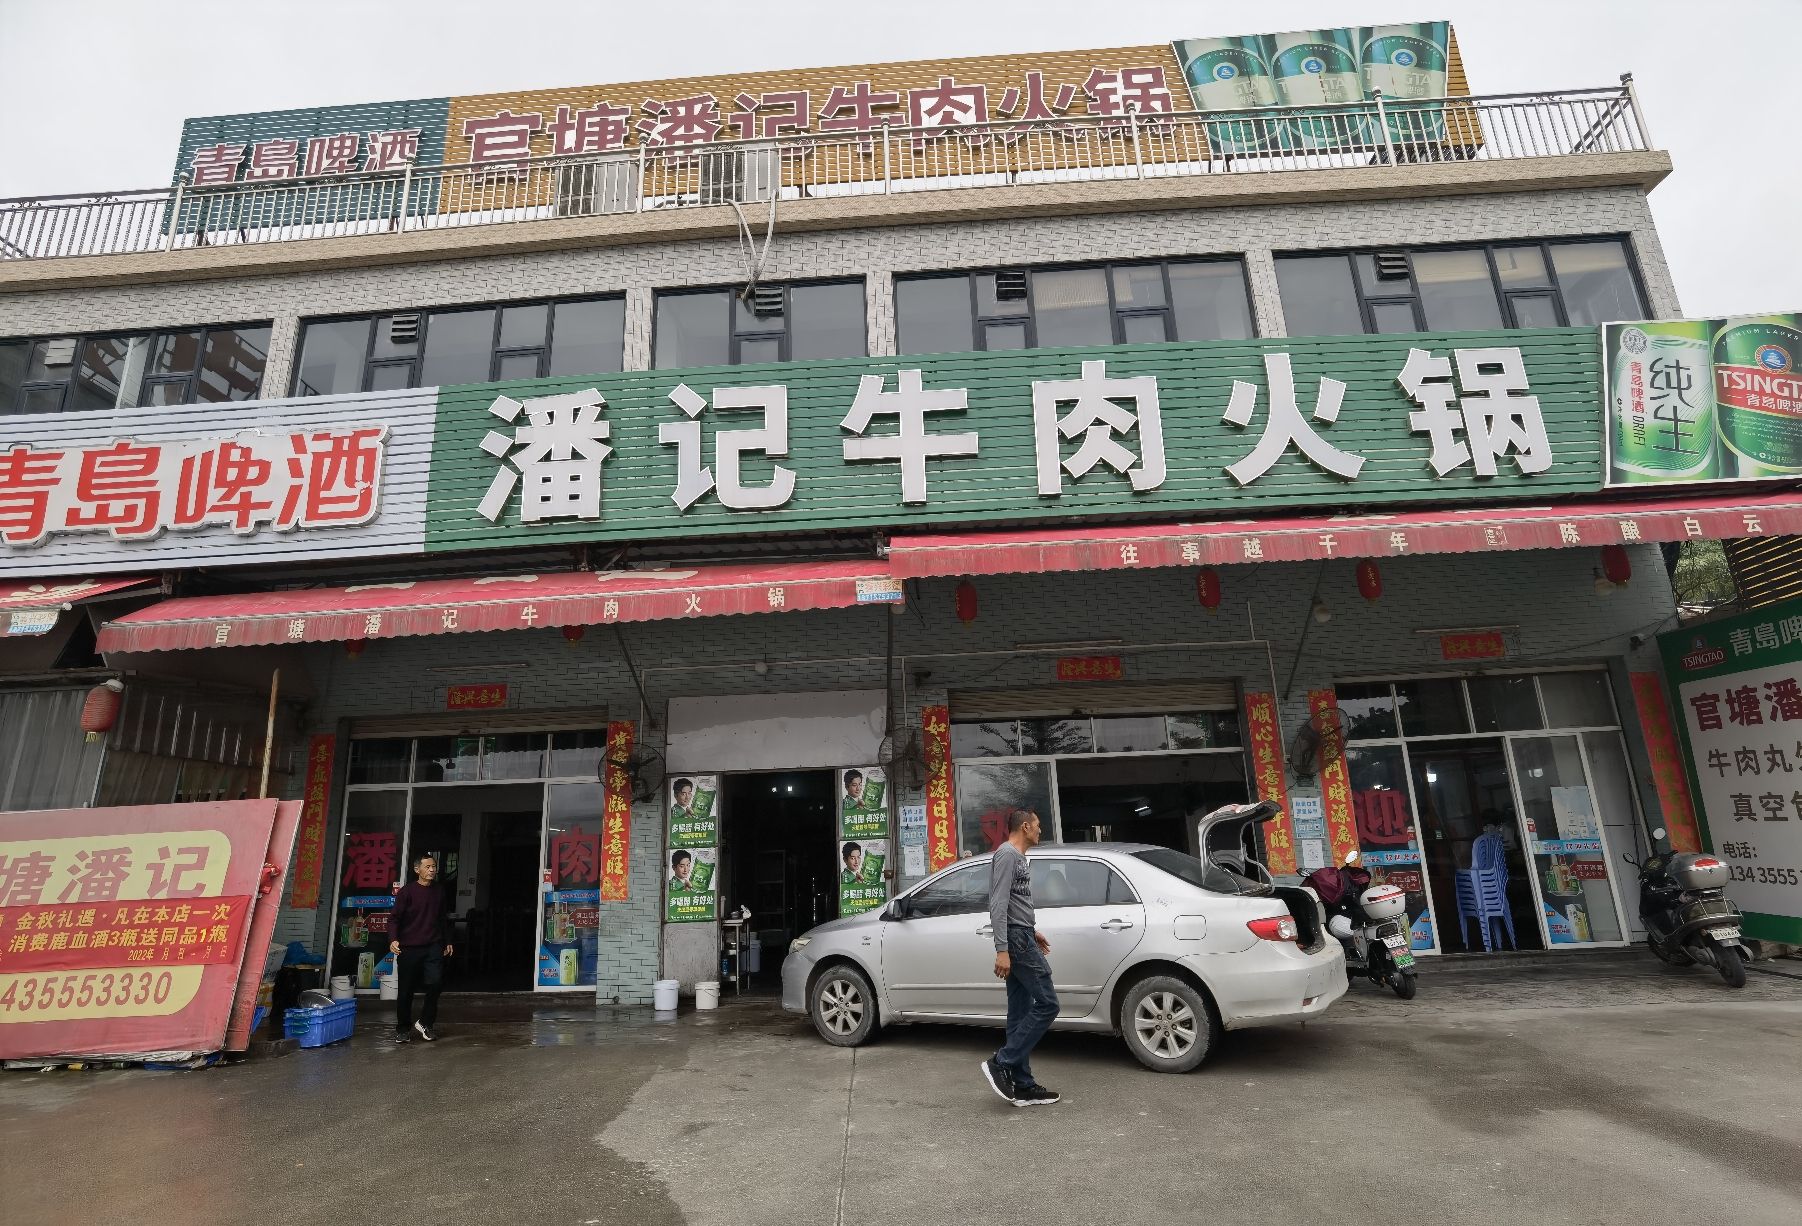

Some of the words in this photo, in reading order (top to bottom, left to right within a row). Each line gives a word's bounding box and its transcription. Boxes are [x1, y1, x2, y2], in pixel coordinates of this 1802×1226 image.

[464, 66, 1175, 181] 官塘潘记牛肉火锅
[1649, 357, 1700, 456] 纯生
[1718, 369, 1802, 399] TSINGT
[476, 347, 1553, 522] 潘记牛肉火锅
[1120, 531, 1409, 565] 往事越千年
[1558, 514, 1763, 544] 陈酿白云
[214, 586, 785, 645] 官塘潘记牛肉火锅
[1683, 650, 1724, 668] TSINGTAO
[1690, 677, 1802, 732] 官塘潘
[343, 832, 397, 889] 潘
[1729, 865, 1802, 886] 1343555
[8, 925, 229, 953] 消费鹿血酒3瓶送同品1瓶
[128, 948, 154, 962] 2022年
[1, 970, 173, 1013] 435553330
